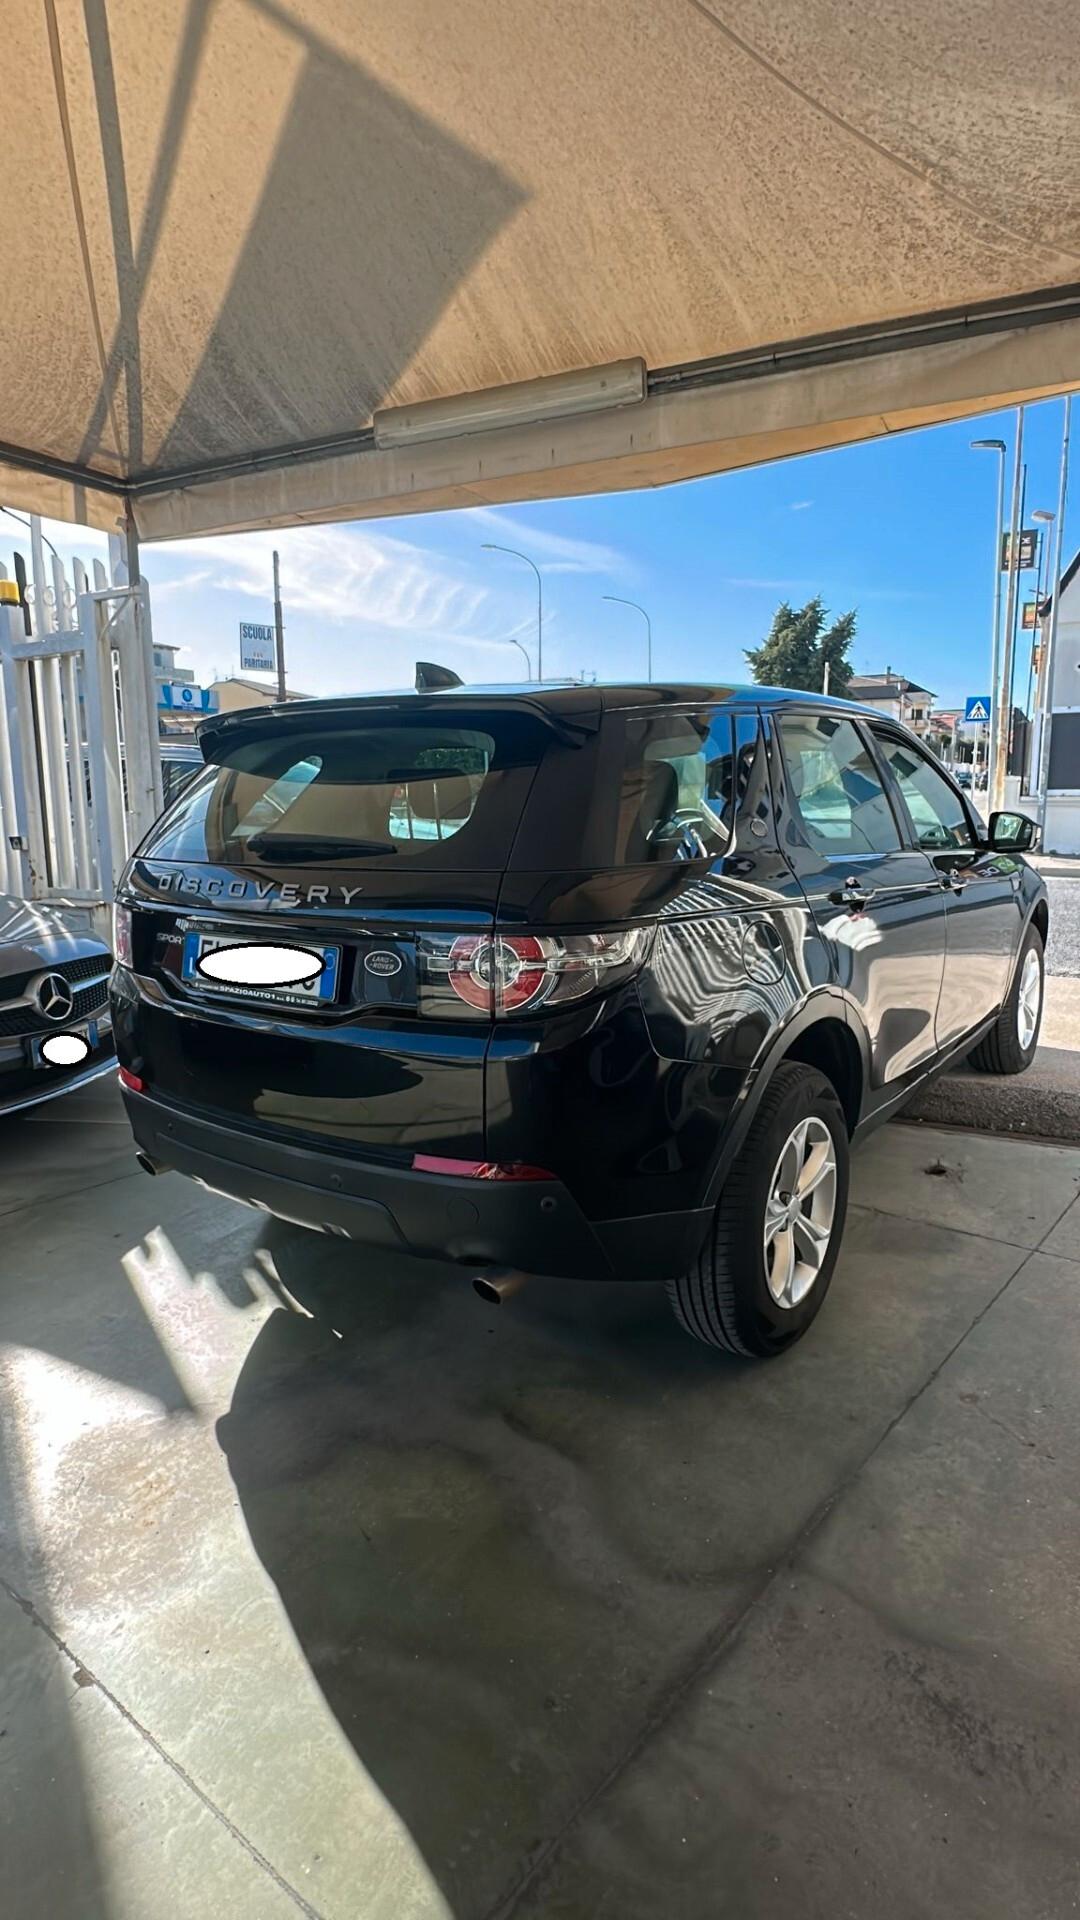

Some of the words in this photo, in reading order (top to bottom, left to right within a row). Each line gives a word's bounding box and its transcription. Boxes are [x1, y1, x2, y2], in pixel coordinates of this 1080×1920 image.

[242, 625, 272, 641] SCUOLA
[158, 875, 362, 905] DISCOVERY
[157, 932, 185, 945] SPOR
[372, 962, 395, 971] ROVER
